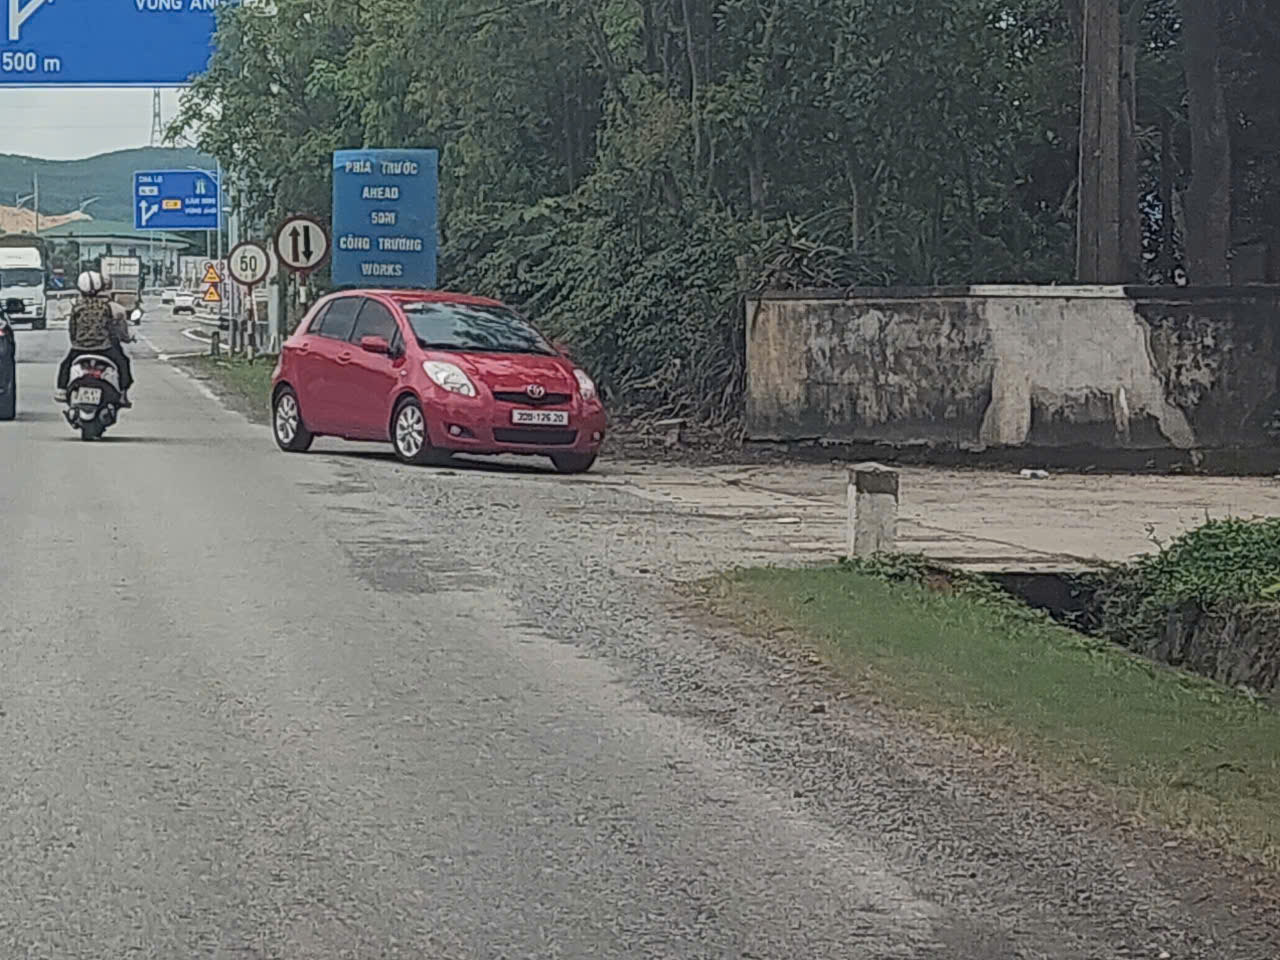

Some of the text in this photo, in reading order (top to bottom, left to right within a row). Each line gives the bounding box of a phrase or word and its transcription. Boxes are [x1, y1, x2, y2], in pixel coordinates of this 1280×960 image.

[2, 51, 61, 72] 500 m
[362, 186, 399, 199] AHEAD
[240, 255, 257, 272] 50
[361, 263, 403, 276] WORKS
